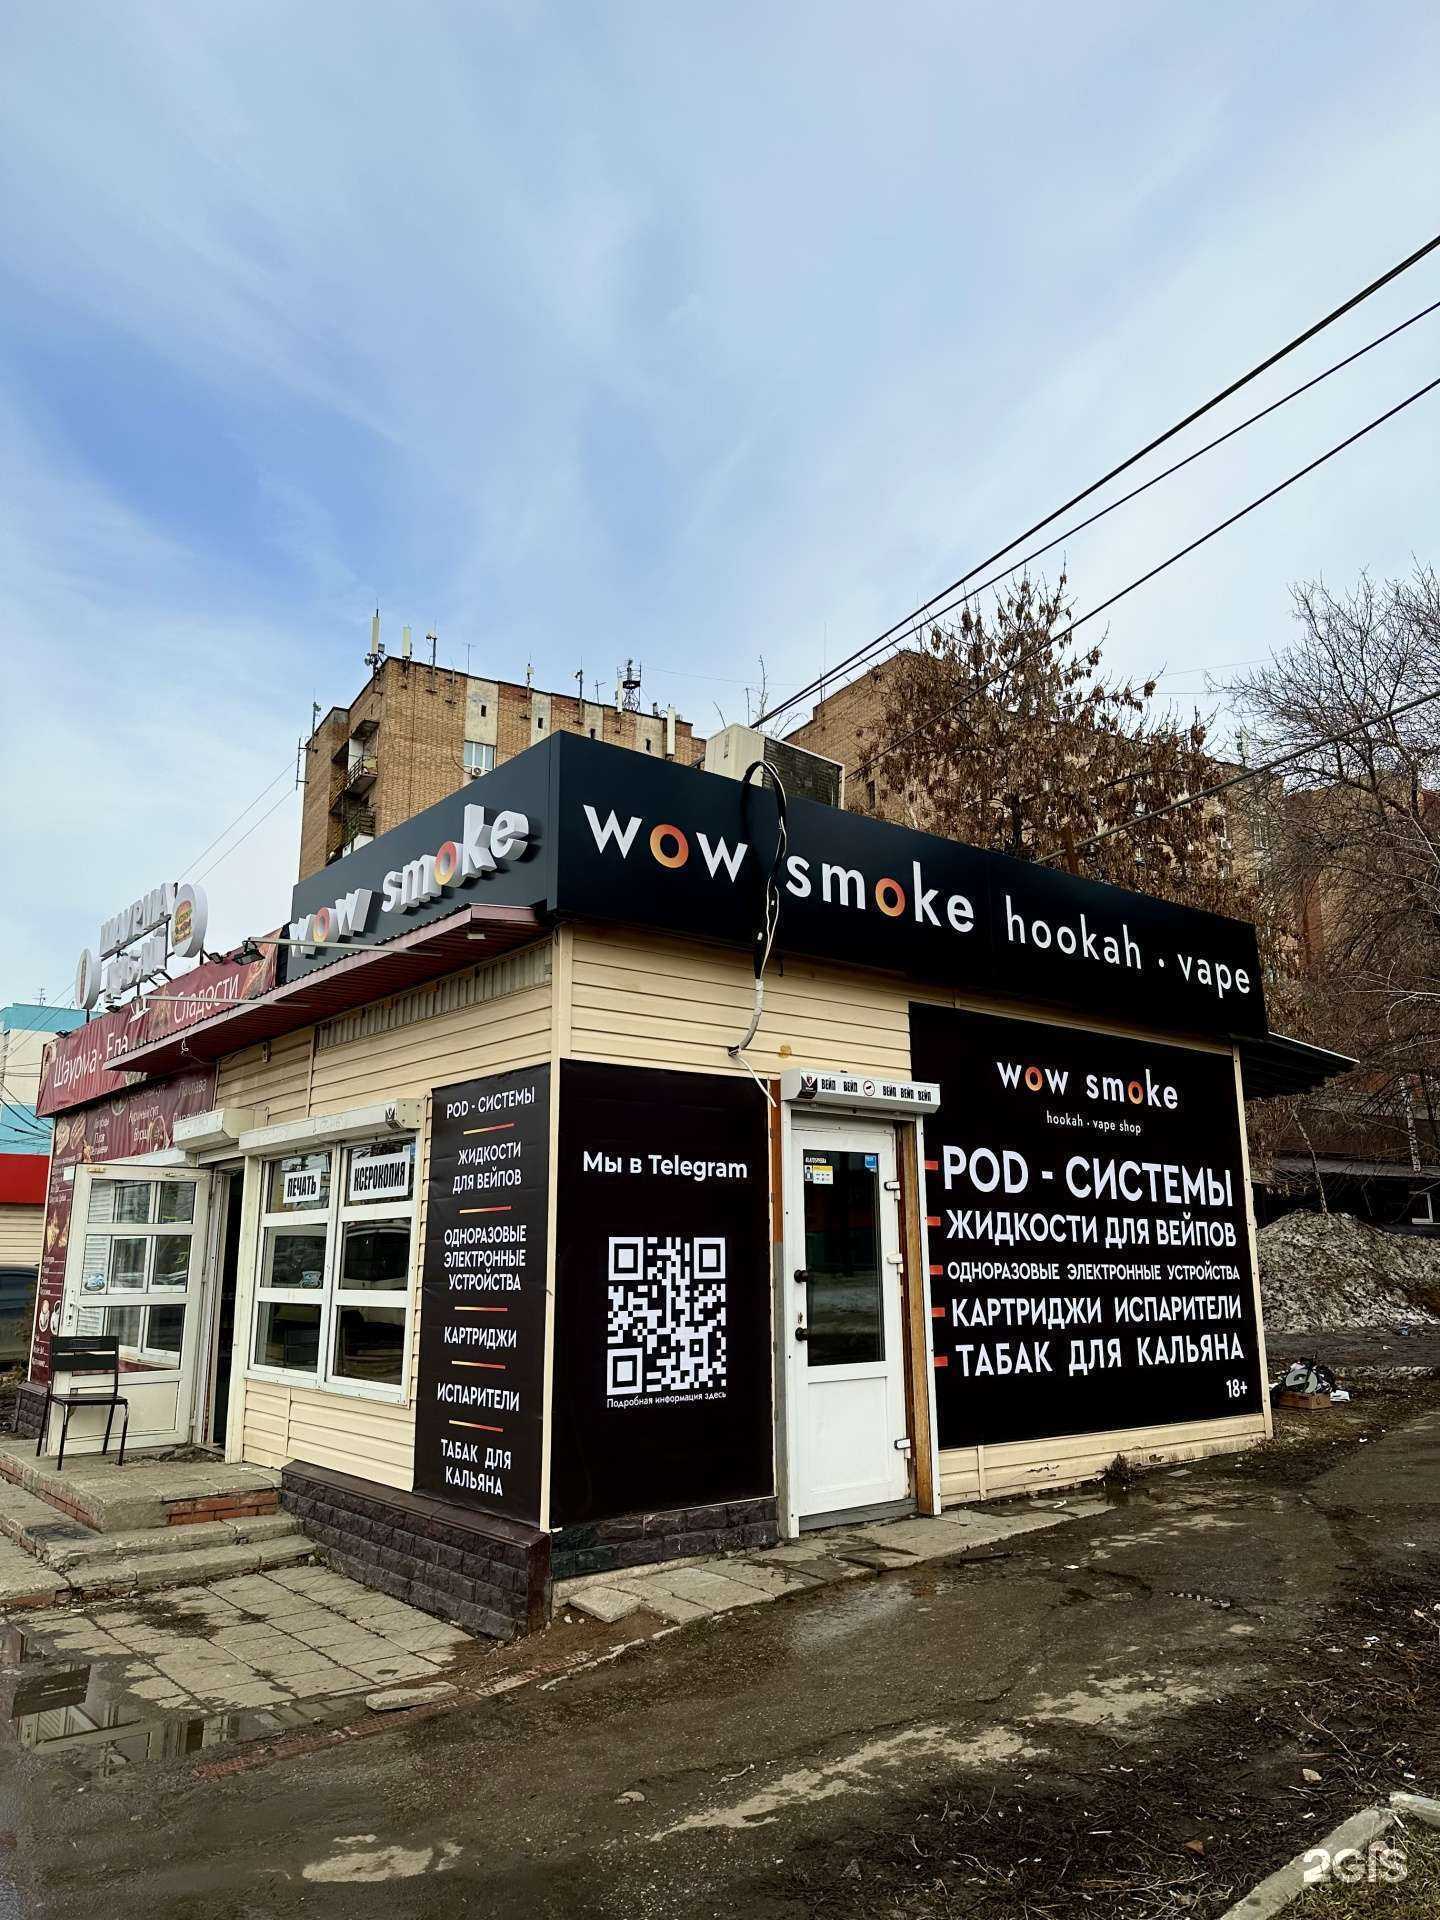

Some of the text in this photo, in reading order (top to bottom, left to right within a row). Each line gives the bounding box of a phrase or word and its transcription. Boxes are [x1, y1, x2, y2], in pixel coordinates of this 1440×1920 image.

[289, 803, 529, 958] wow smoke
[583, 804, 748, 883] wow
[785, 855, 975, 933] smoke
[1005, 894, 1142, 969] hookah
[1177, 954, 1250, 998] vape
[53, 1048, 98, 1092] Шаурма
[174, 973, 240, 1024] Сладости
[996, 1062, 1179, 1109] wow smoke
[446, 1100, 468, 1119] POD
[478, 1086, 535, 1113] СИСТЕМЫ
[1046, 1110, 1083, 1127] hookah
[1093, 1119, 1116, 1133] vape
[1119, 1120, 1142, 1136] shop
[457, 1141, 521, 1166] ЖИДКОСТИ
[583, 1151, 748, 1181] Мы в Telegram
[287, 1175, 317, 1197] ПЕЧАТЬ
[353, 1161, 406, 1192] КСЕРОКОПИЯ
[452, 1167, 522, 1194] ДЛЯ ВЕЙПОВ
[942, 1145, 1029, 1194] POD
[1065, 1155, 1233, 1207] СИСТЕМЫ
[444, 1225, 527, 1248] ОДНОРАЗОВЫЕ
[946, 1210, 1237, 1249] ЖИДКОСТИ ДЛЯ ВЕЙПОВ
[443, 1249, 526, 1268] ЭЛЕКТРОННЫЕ
[947, 1260, 1240, 1282] ОДНОРАЗОВЫЕ ЭЛЕКТРОННЫЕ УСТРОЙСТВА
[448, 1267, 521, 1291] УСТРОЙСТВА
[952, 1295, 1242, 1330] КАРТРИДЖИ ИСПАРИТЕЛИ
[443, 1326, 517, 1349] КАРТРИДЖИ
[955, 1332, 1245, 1377] ТАБАК ДЛЯ КАЛЬЯНА
[437, 1382, 520, 1411] ИСПАРИТЕЛИ
[606, 1391, 727, 1408] Подробная информация здесь
[1226, 1379, 1248, 1398] 18+
[440, 1438, 512, 1470] ТАБАК ДЛЯ
[445, 1465, 503, 1497] КАЛЬЯНА
